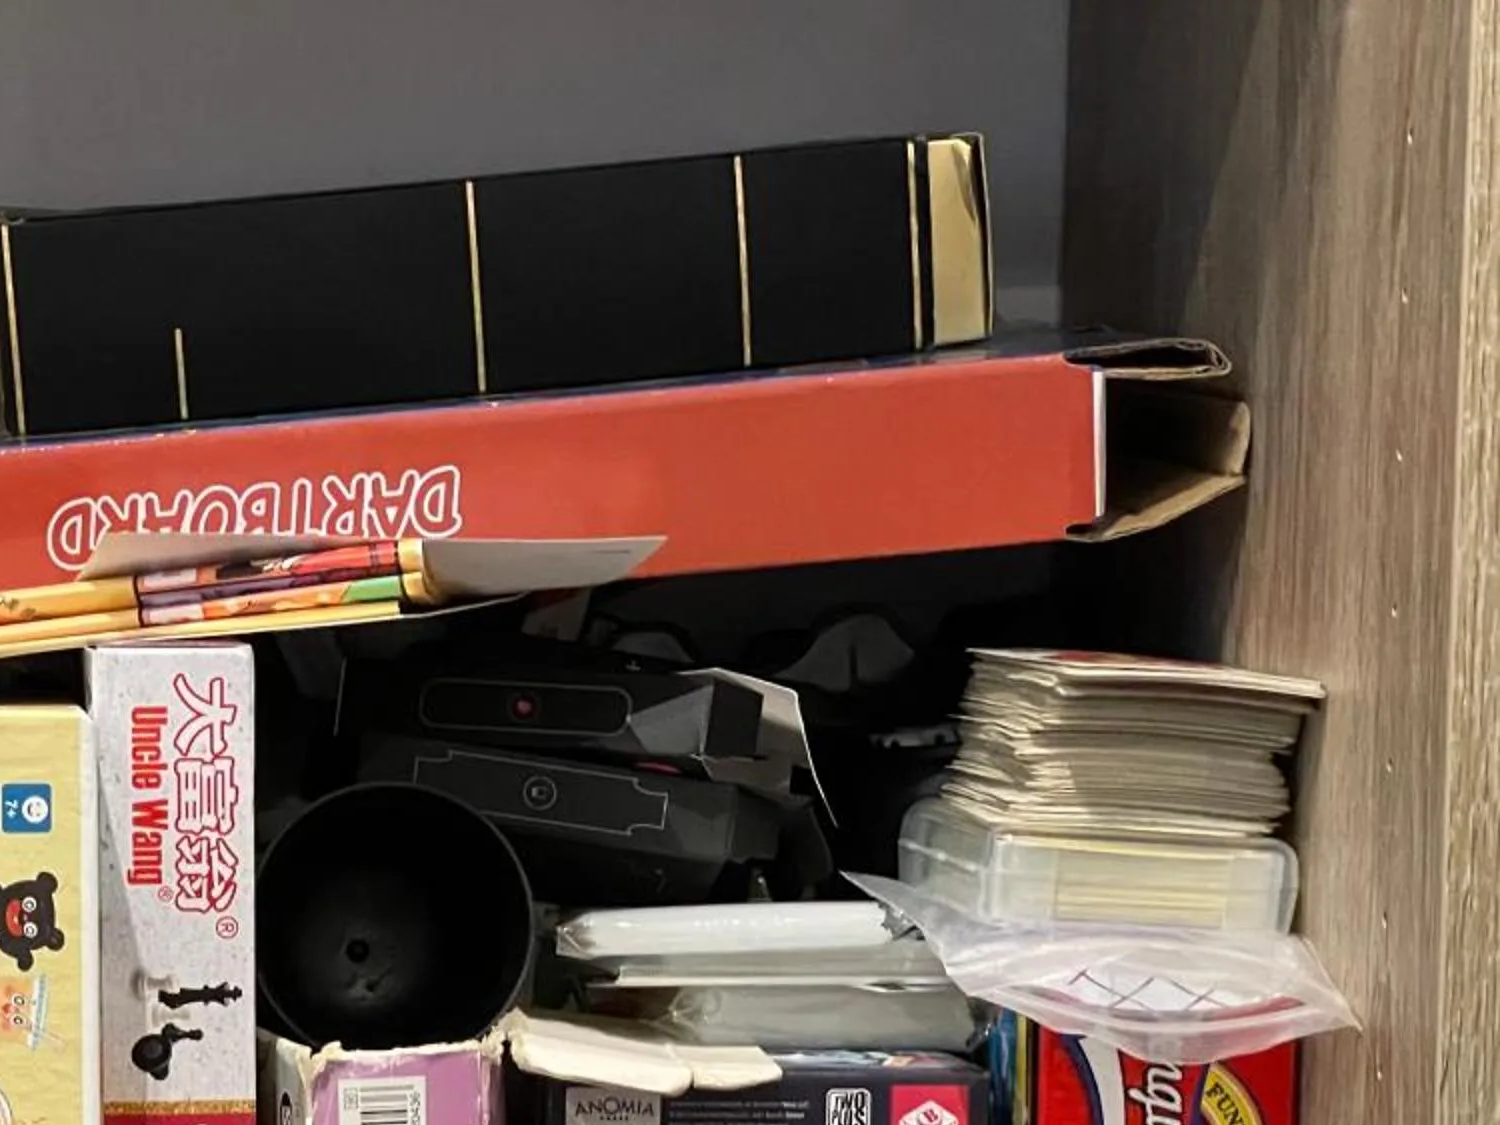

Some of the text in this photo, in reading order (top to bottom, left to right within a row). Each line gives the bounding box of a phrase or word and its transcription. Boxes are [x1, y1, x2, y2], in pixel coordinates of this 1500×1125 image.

[47, 465, 463, 571] DARTBOARD
[127, 706, 168, 886] Uncle Wang
[173, 673, 238, 912] 大富翁
[575, 1095, 655, 1118] ANOMIA
